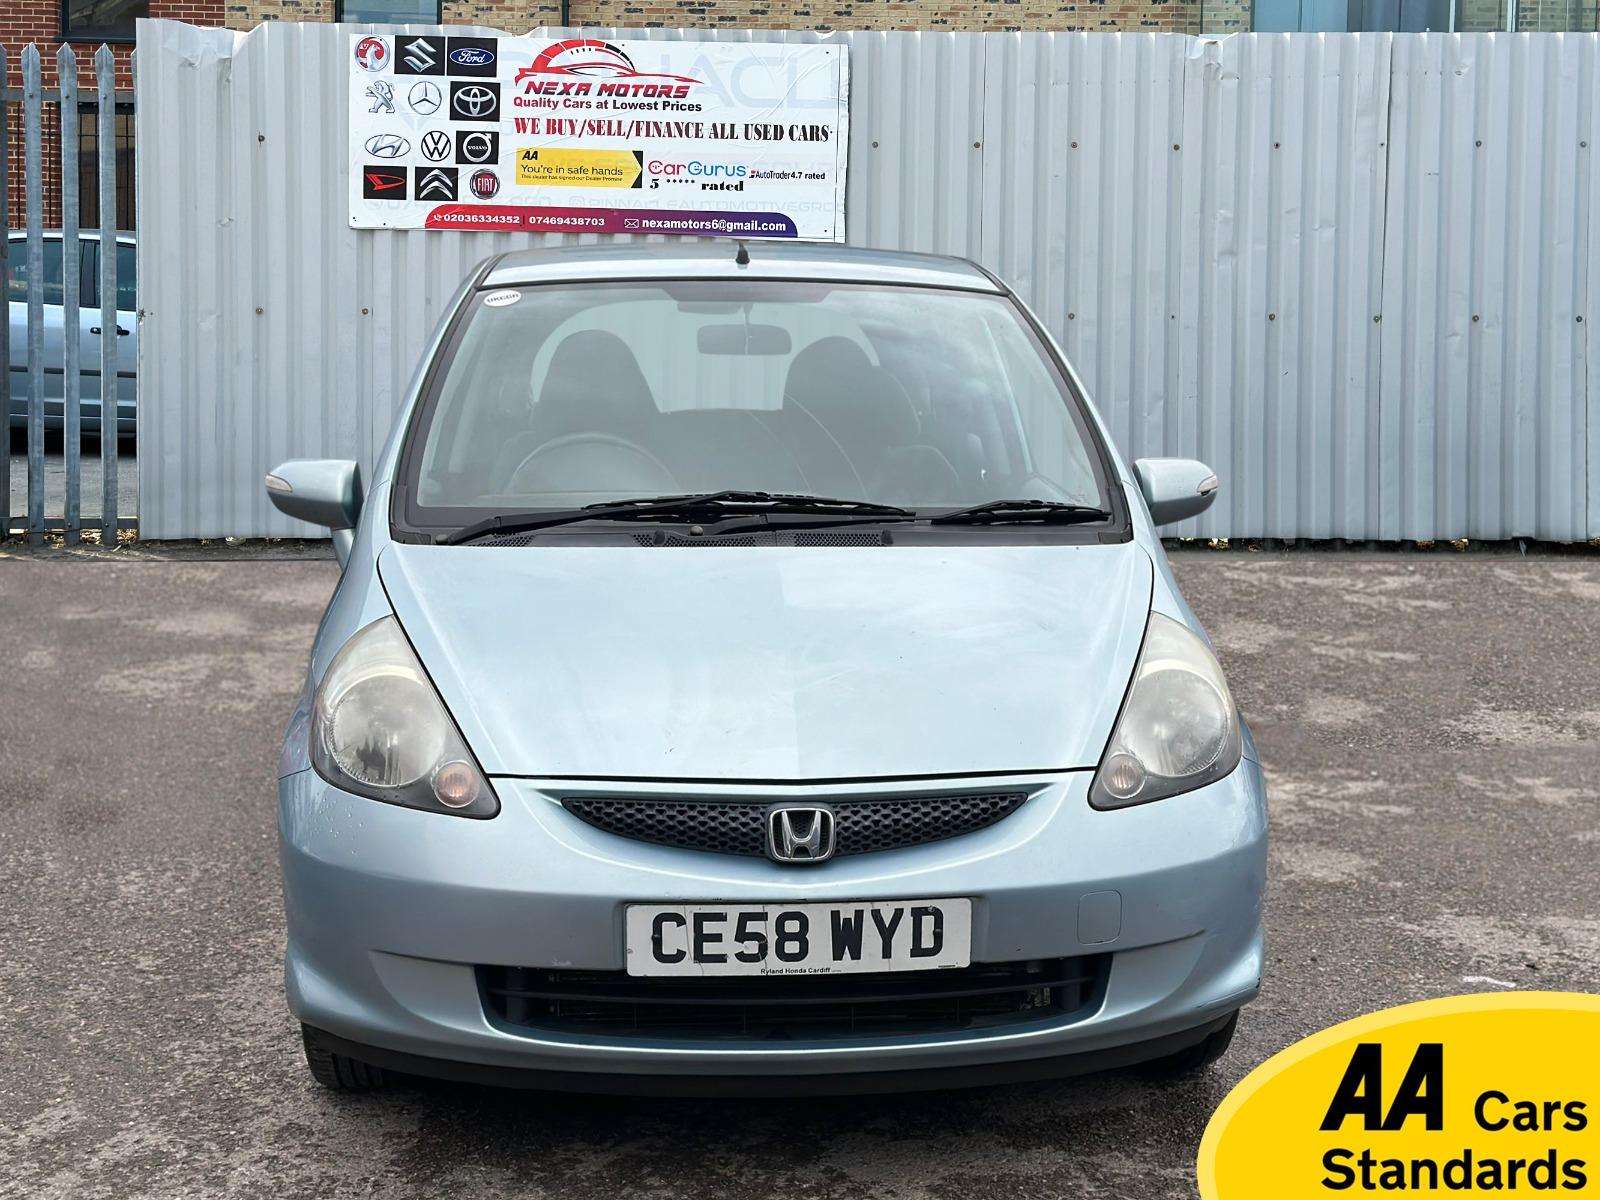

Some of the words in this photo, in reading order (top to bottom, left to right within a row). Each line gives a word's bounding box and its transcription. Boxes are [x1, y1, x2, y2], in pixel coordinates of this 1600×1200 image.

[458, 51, 486, 63] Ford
[524, 81, 592, 96] NEXA
[597, 84, 690, 99] MOTORS
[513, 96, 559, 110] Quality
[563, 98, 592, 109] Cars
[596, 99, 608, 109] at
[612, 99, 658, 111] Lowest
[662, 101, 702, 111] Prices
[514, 117, 540, 135] WE
[546, 117, 703, 139] BUY/SELL/FINANCE
[709, 122, 739, 140] ALL
[744, 123, 785, 141] USED
[789, 124, 829, 142] CARS
[521, 150, 538, 161] AA
[521, 164, 553, 173] You're
[555, 165, 565, 173] in
[567, 166, 589, 174] safe
[592, 167, 623, 176] hands
[648, 160, 747, 177] CarGurus
[755, 170, 791, 180] AutoTrader
[804, 171, 826, 180] rated
[477, 178, 494, 192] FIAT
[650, 178, 659, 189] 5
[701, 180, 744, 192] rated
[444, 214, 520, 224] 02036334352
[529, 215, 605, 226] 07469438703
[642, 218, 786, 233] nexamotors6@gmail.com
[651, 911, 809, 964] CE58
[830, 906, 944, 961] WYD
